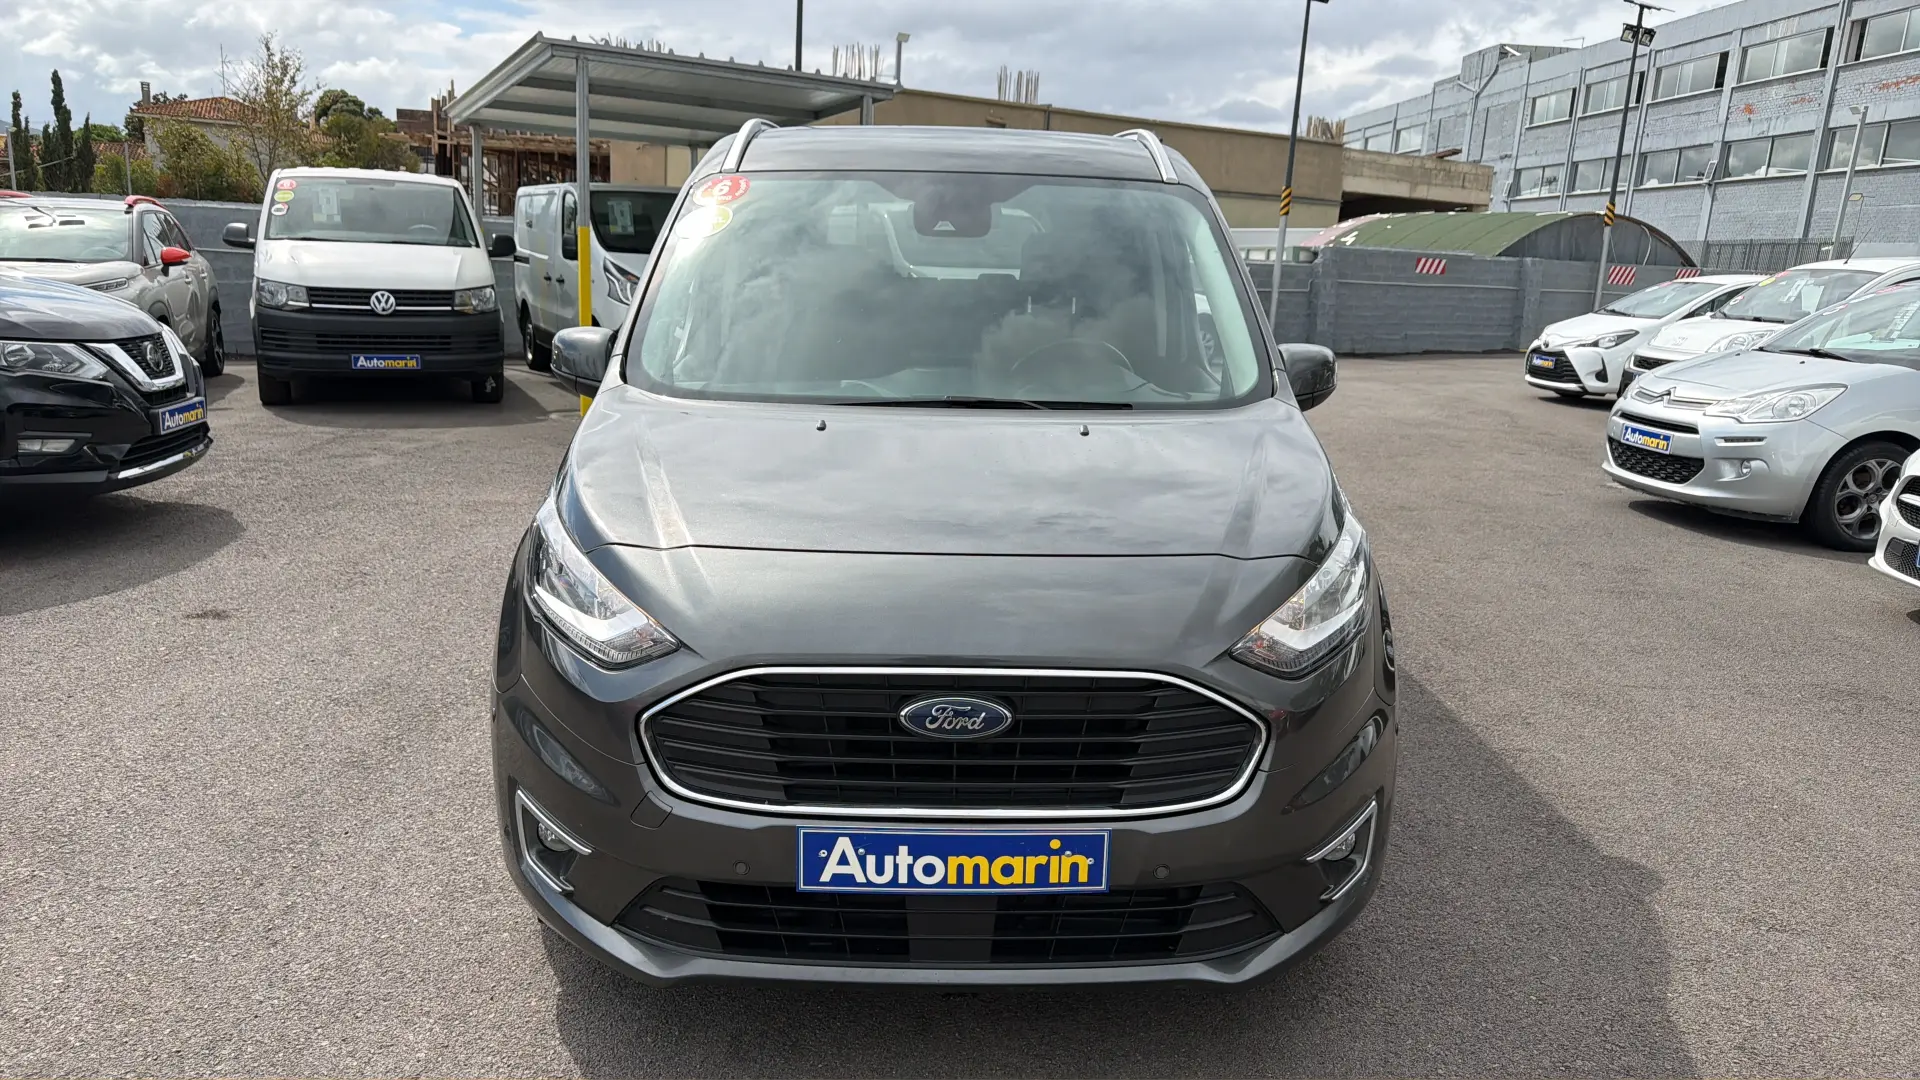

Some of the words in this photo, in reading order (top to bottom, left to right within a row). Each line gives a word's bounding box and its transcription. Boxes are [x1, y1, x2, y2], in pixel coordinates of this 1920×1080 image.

[357, 355, 417, 368] Automarin
[164, 404, 204, 430] Automarin
[1624, 427, 1668, 450] Automarin
[925, 704, 986, 730] Ford
[819, 836, 1089, 885] Automarin
